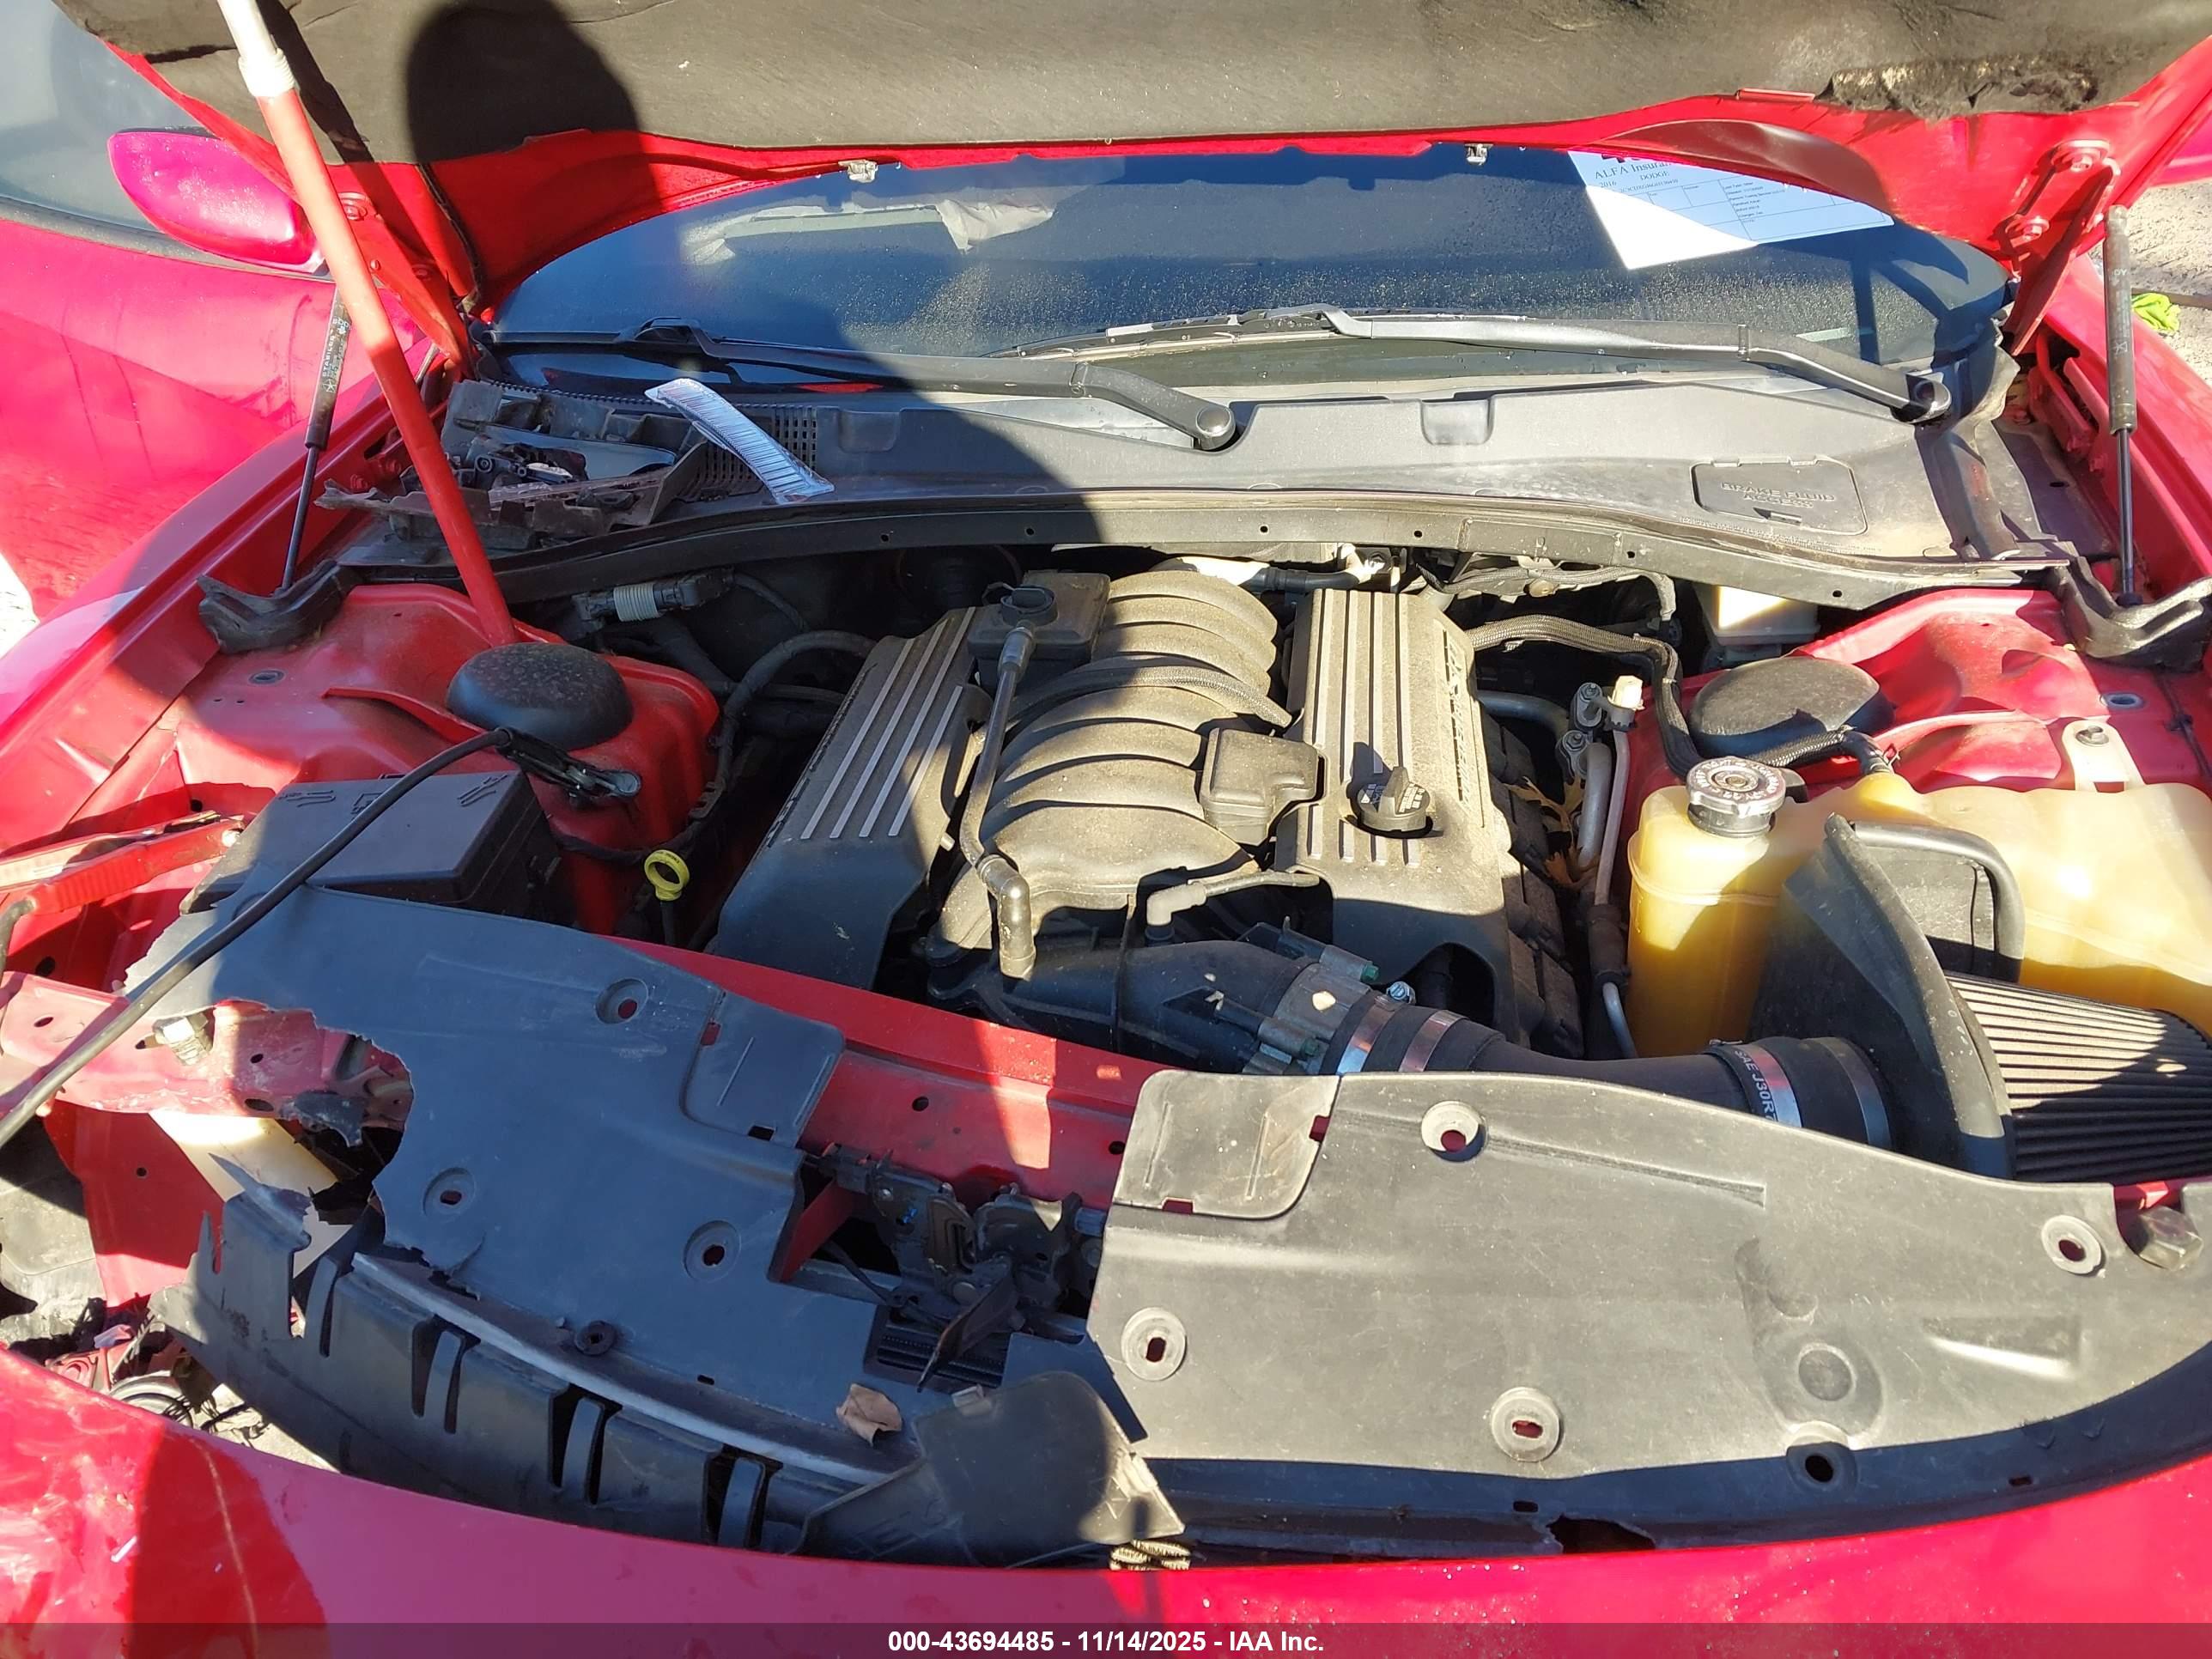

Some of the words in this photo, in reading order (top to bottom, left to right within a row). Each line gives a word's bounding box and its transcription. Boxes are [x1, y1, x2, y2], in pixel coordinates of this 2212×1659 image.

[1595, 165, 1629, 179] ALFA
[1639, 171, 1670, 181] DODGE
[1600, 179, 1617, 188] 2016
[1720, 481, 1781, 498] BRAKE
[1784, 490, 1835, 502] FLUID
[1743, 493, 1814, 509] ACCESS
[1735, 1050, 1759, 1072] SAE
